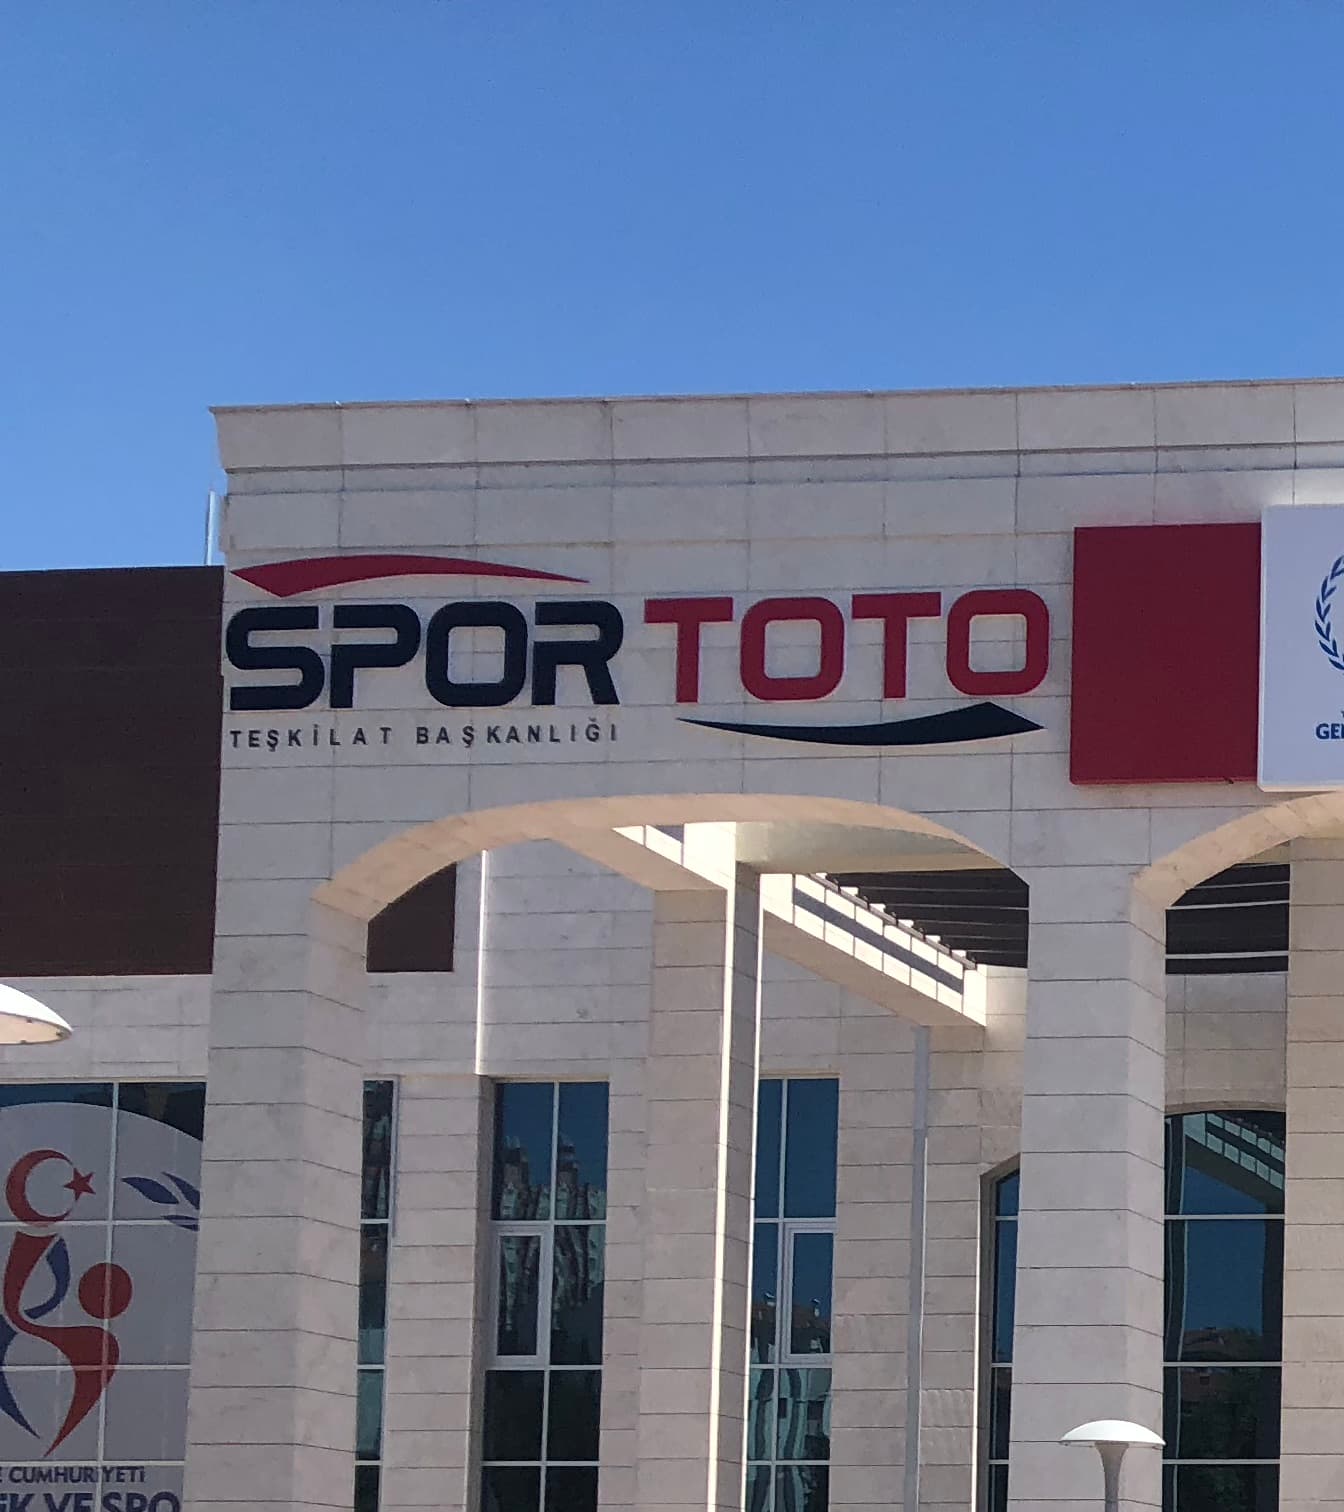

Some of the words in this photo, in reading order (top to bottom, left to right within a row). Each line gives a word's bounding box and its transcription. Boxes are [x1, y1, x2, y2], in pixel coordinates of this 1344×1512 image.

[225, 600, 624, 711] SPOR
[643, 588, 1051, 704] TOTO
[229, 725, 394, 754] TEŞKİLAT
[415, 716, 620, 750] BAŞKANLIĞI
